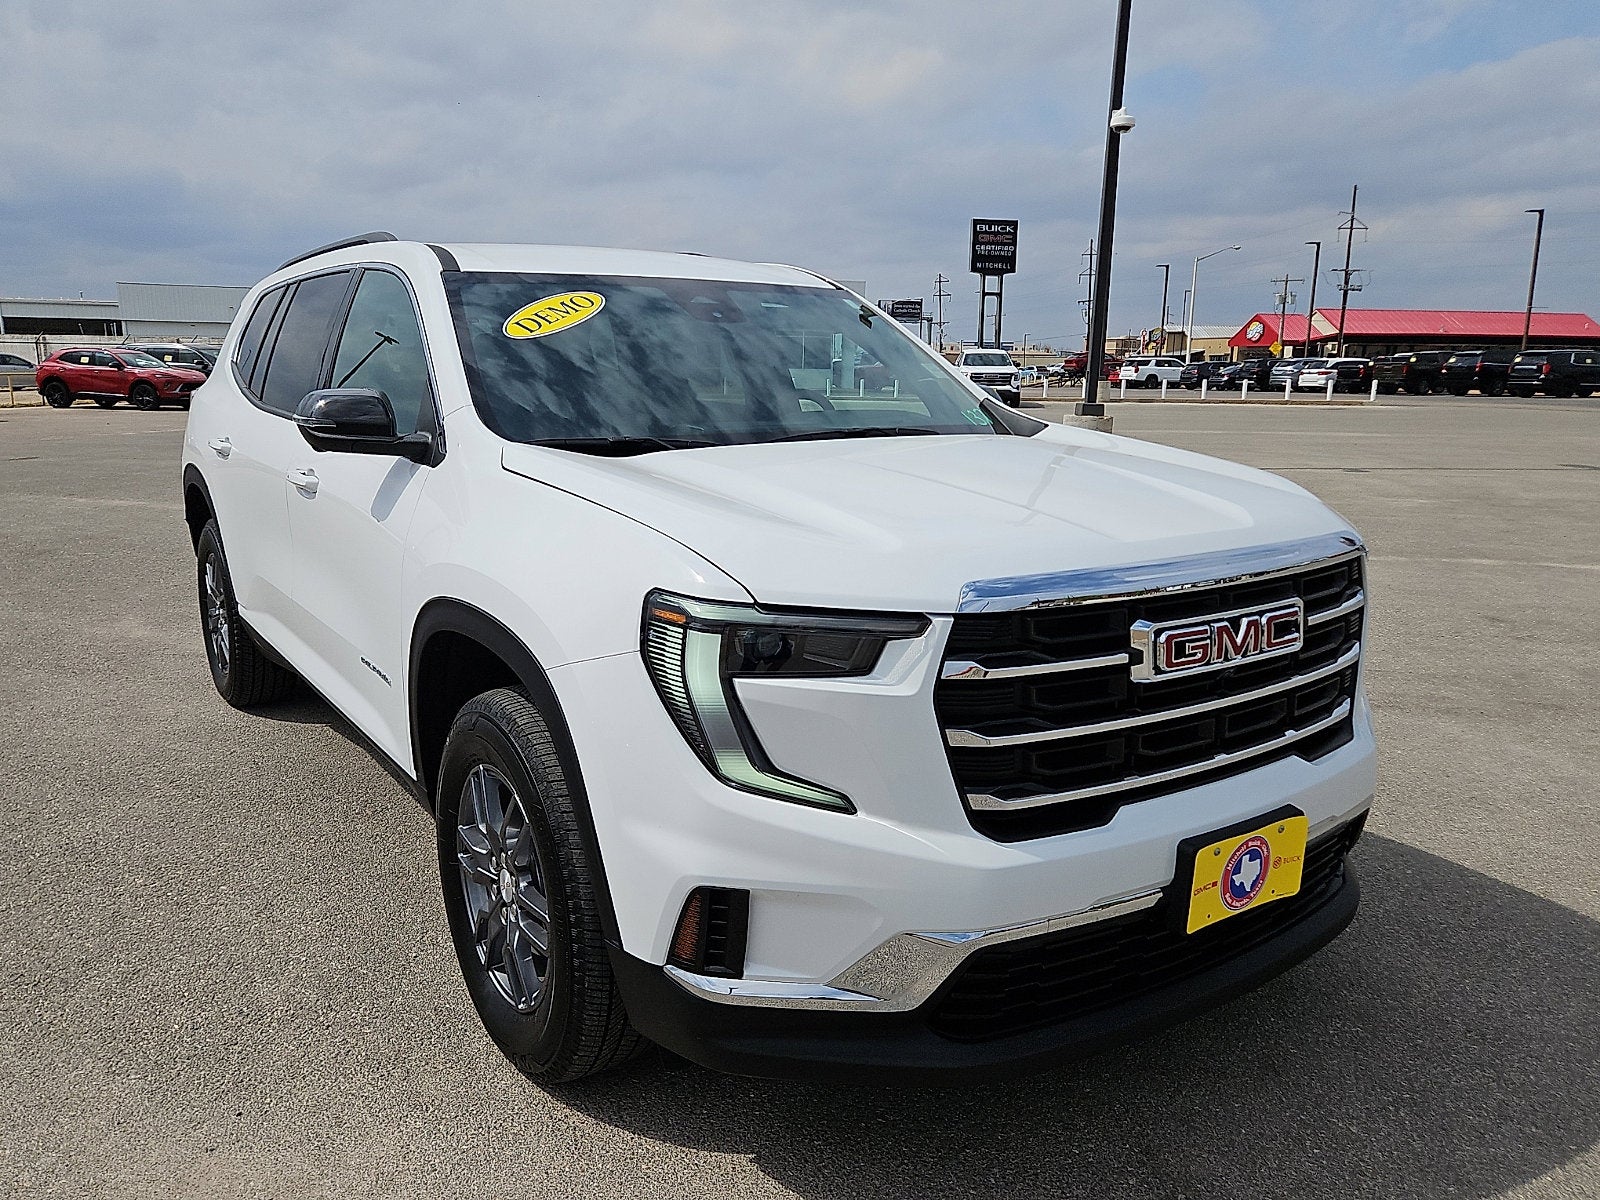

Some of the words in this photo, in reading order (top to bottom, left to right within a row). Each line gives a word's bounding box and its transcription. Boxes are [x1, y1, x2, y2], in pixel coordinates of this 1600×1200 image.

[976, 224, 1015, 233] BUICK
[978, 233, 1013, 243] GMC
[511, 295, 595, 334] DEMO
[1157, 607, 1300, 671] GMC
[1283, 855, 1301, 864] BUICK
[1193, 882, 1212, 897] GMC
